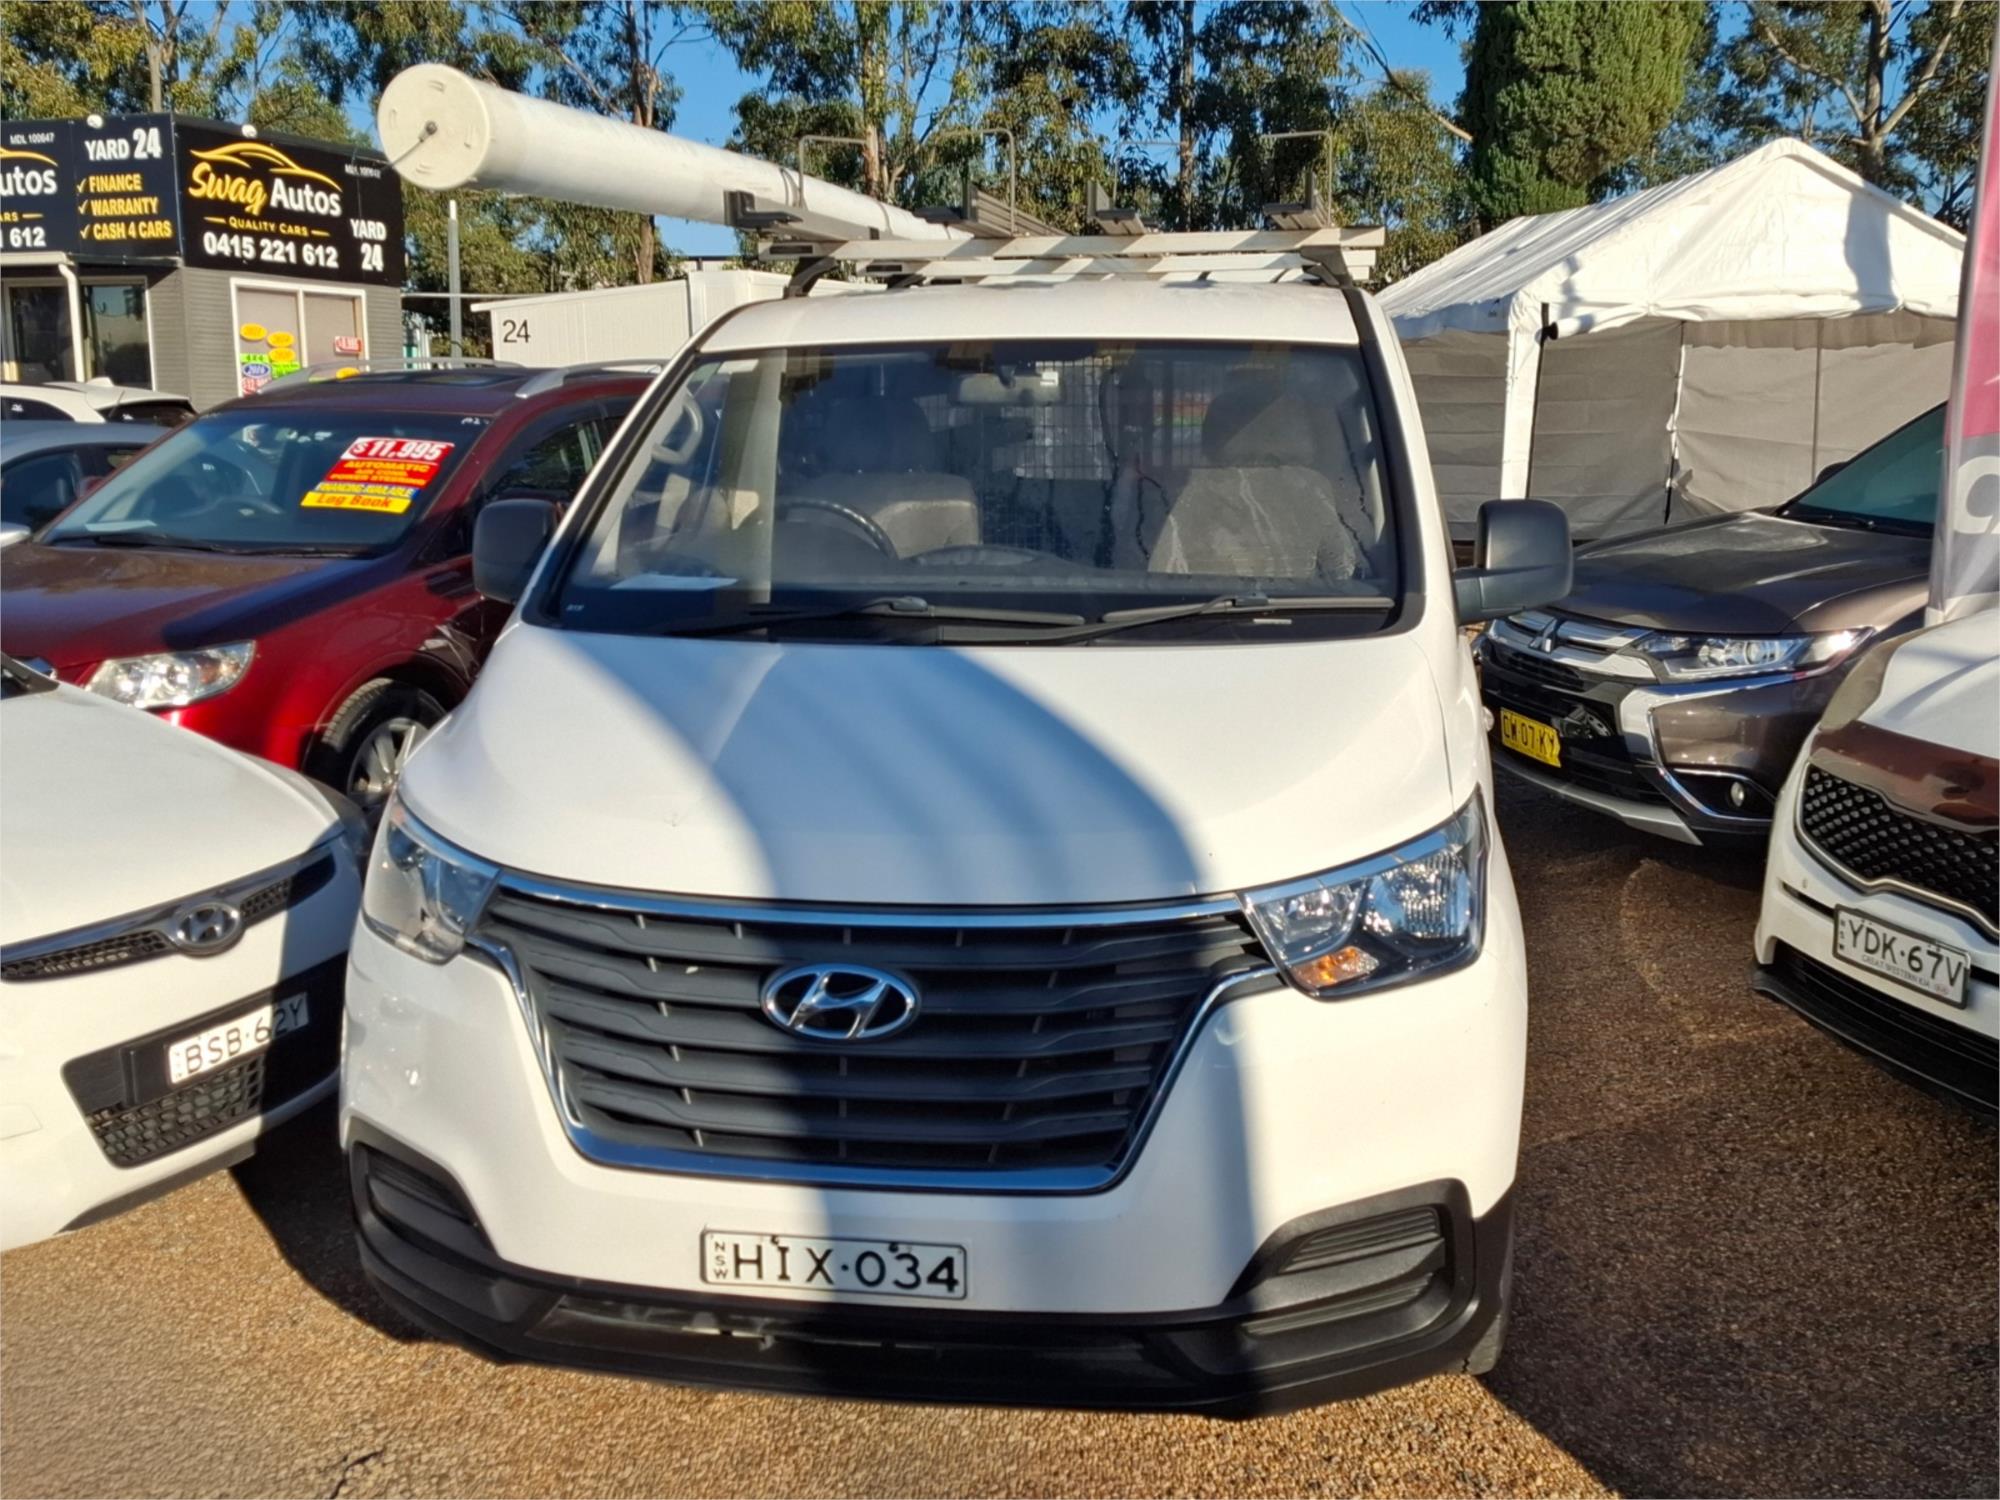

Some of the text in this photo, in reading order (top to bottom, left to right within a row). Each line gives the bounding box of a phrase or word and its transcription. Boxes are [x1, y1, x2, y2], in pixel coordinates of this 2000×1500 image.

[85, 128, 162, 161] YARD 24
[89, 174, 142, 192] FINANCE
[188, 161, 343, 217] Swag Autos
[91, 197, 158, 216] WARRANTY
[10, 226, 47, 248] 612
[93, 220, 172, 240] CASH 4 CARS
[229, 216, 309, 236] QUALITY CARS
[350, 219, 387, 241] YARD
[203, 232, 339, 269] 0415 221 612
[361, 243, 384, 272] 24
[502, 319, 531, 343] 24
[343, 460, 431, 473] AUTOMATIC
[317, 493, 391, 508] Log Book
